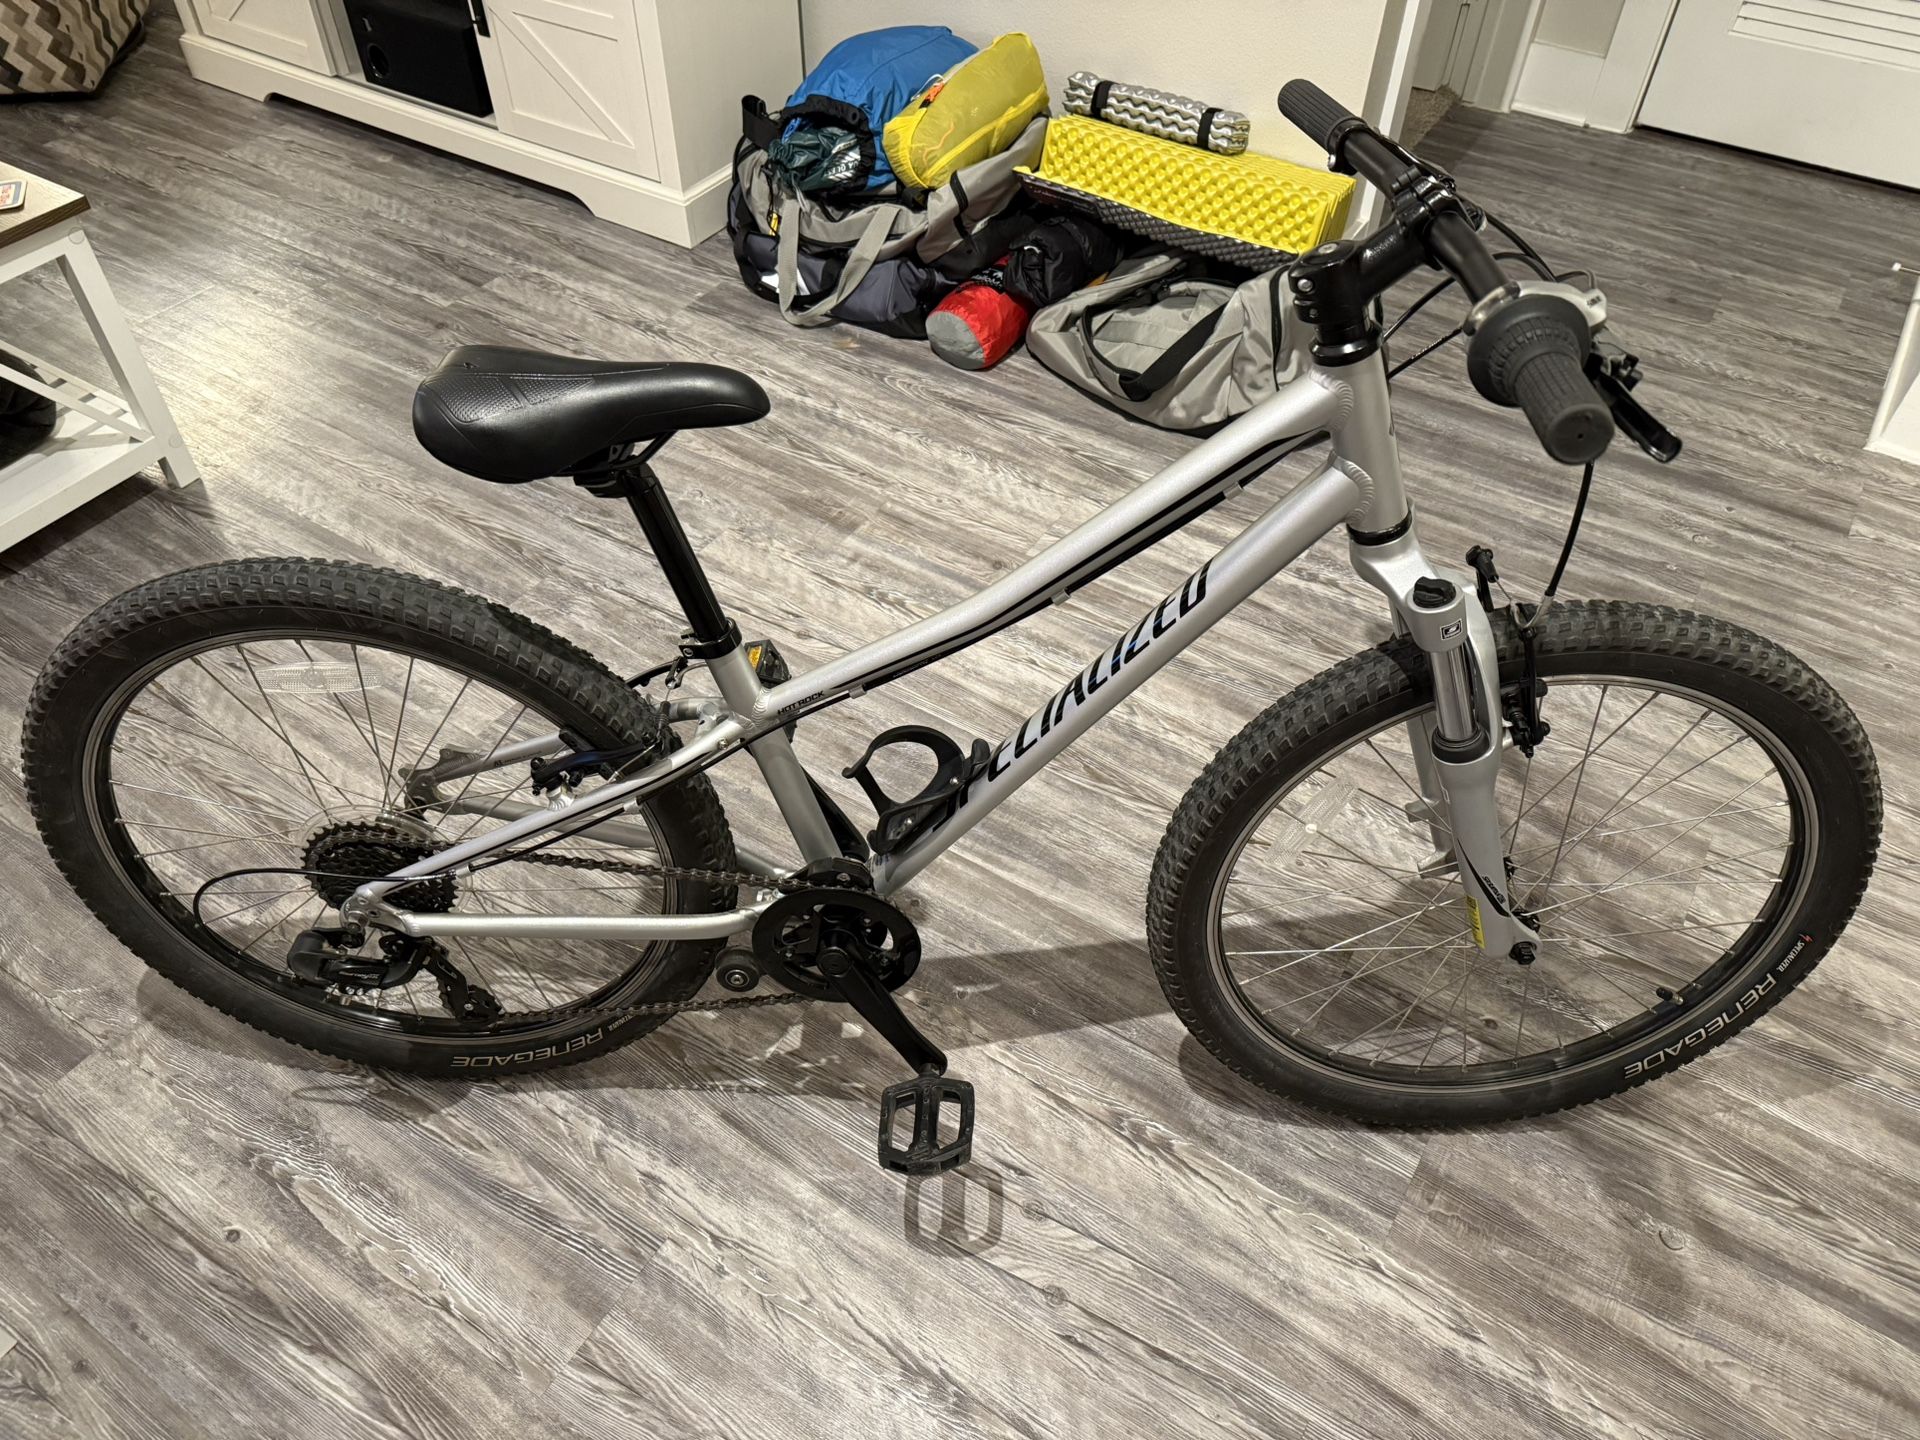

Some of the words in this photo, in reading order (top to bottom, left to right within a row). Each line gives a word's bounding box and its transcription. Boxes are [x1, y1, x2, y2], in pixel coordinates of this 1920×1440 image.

[798, 690, 825, 706] ROCK
[932, 557, 1214, 832] ECIALIZED
[450, 1027, 604, 1067] RENEGADE
[1624, 972, 1777, 1079] RENEGADE
